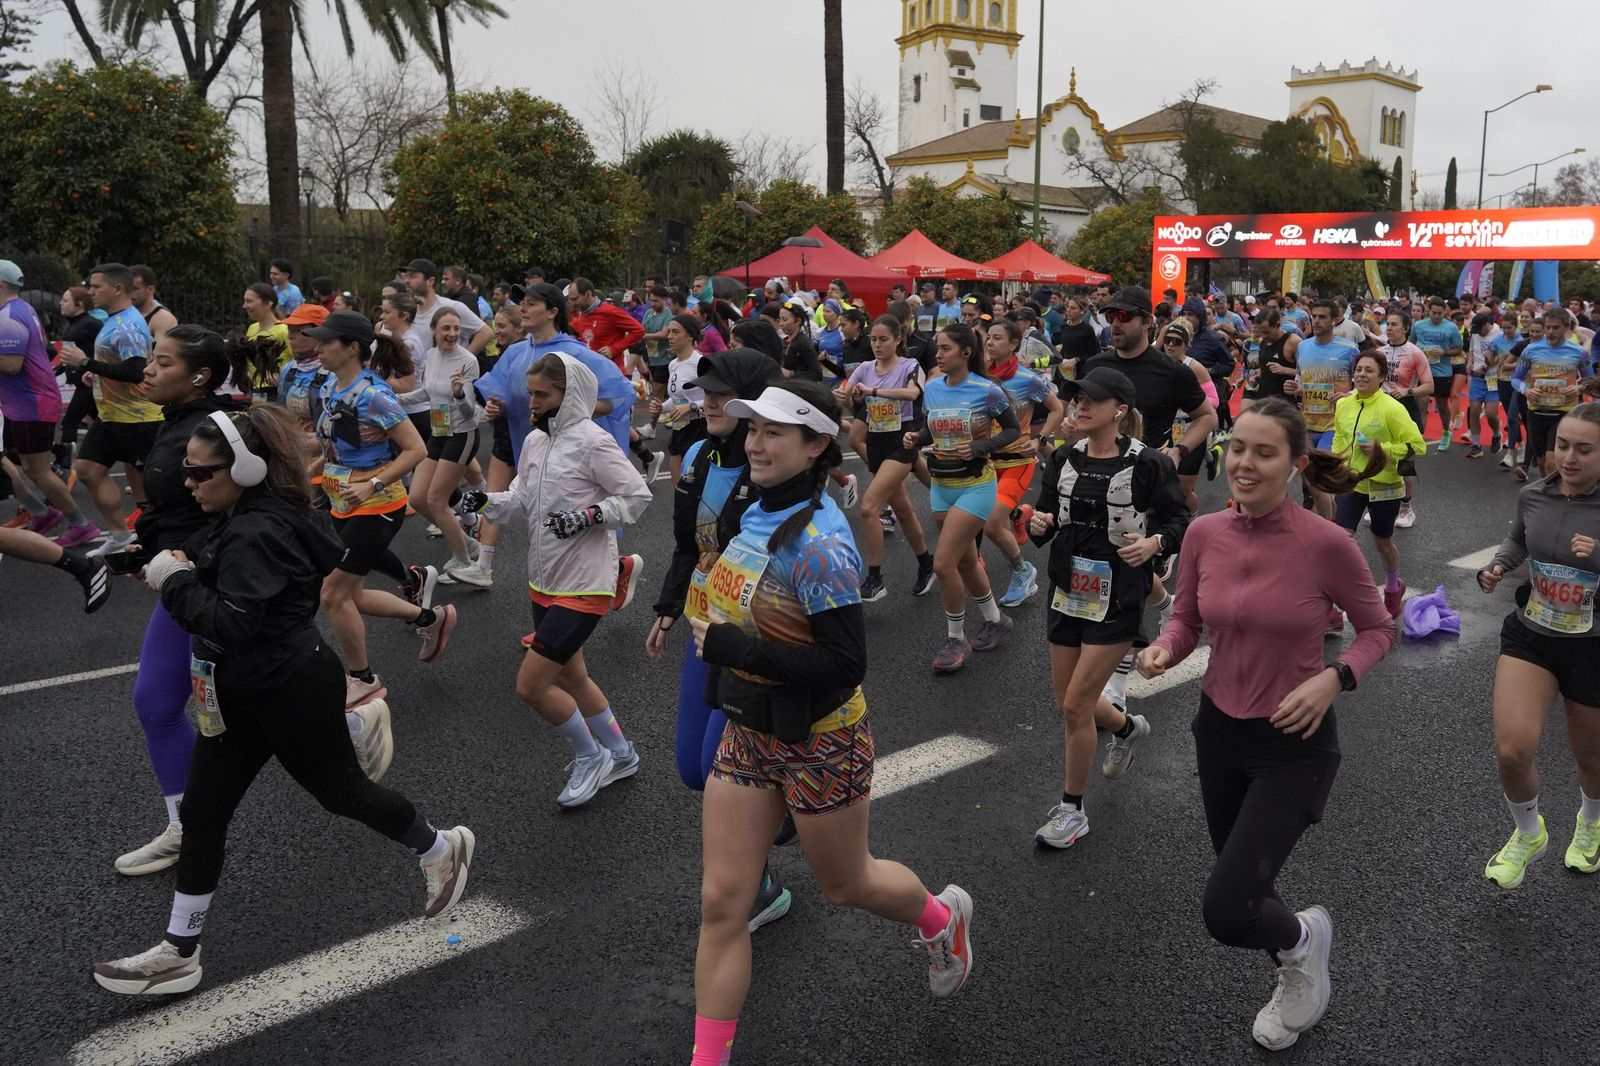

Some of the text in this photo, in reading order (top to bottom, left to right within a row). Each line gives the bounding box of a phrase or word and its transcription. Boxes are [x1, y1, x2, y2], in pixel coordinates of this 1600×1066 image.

[1431, 219, 1504, 235] maratón
[1235, 231, 1273, 242] Sprinter
[1313, 228, 1358, 244] HOKA
[1445, 232, 1501, 248] sevilla
[1304, 391, 1329, 401] 17442
[932, 418, 963, 432] 19955
[1071, 572, 1101, 593] 324
[1533, 576, 1585, 606] 19465
